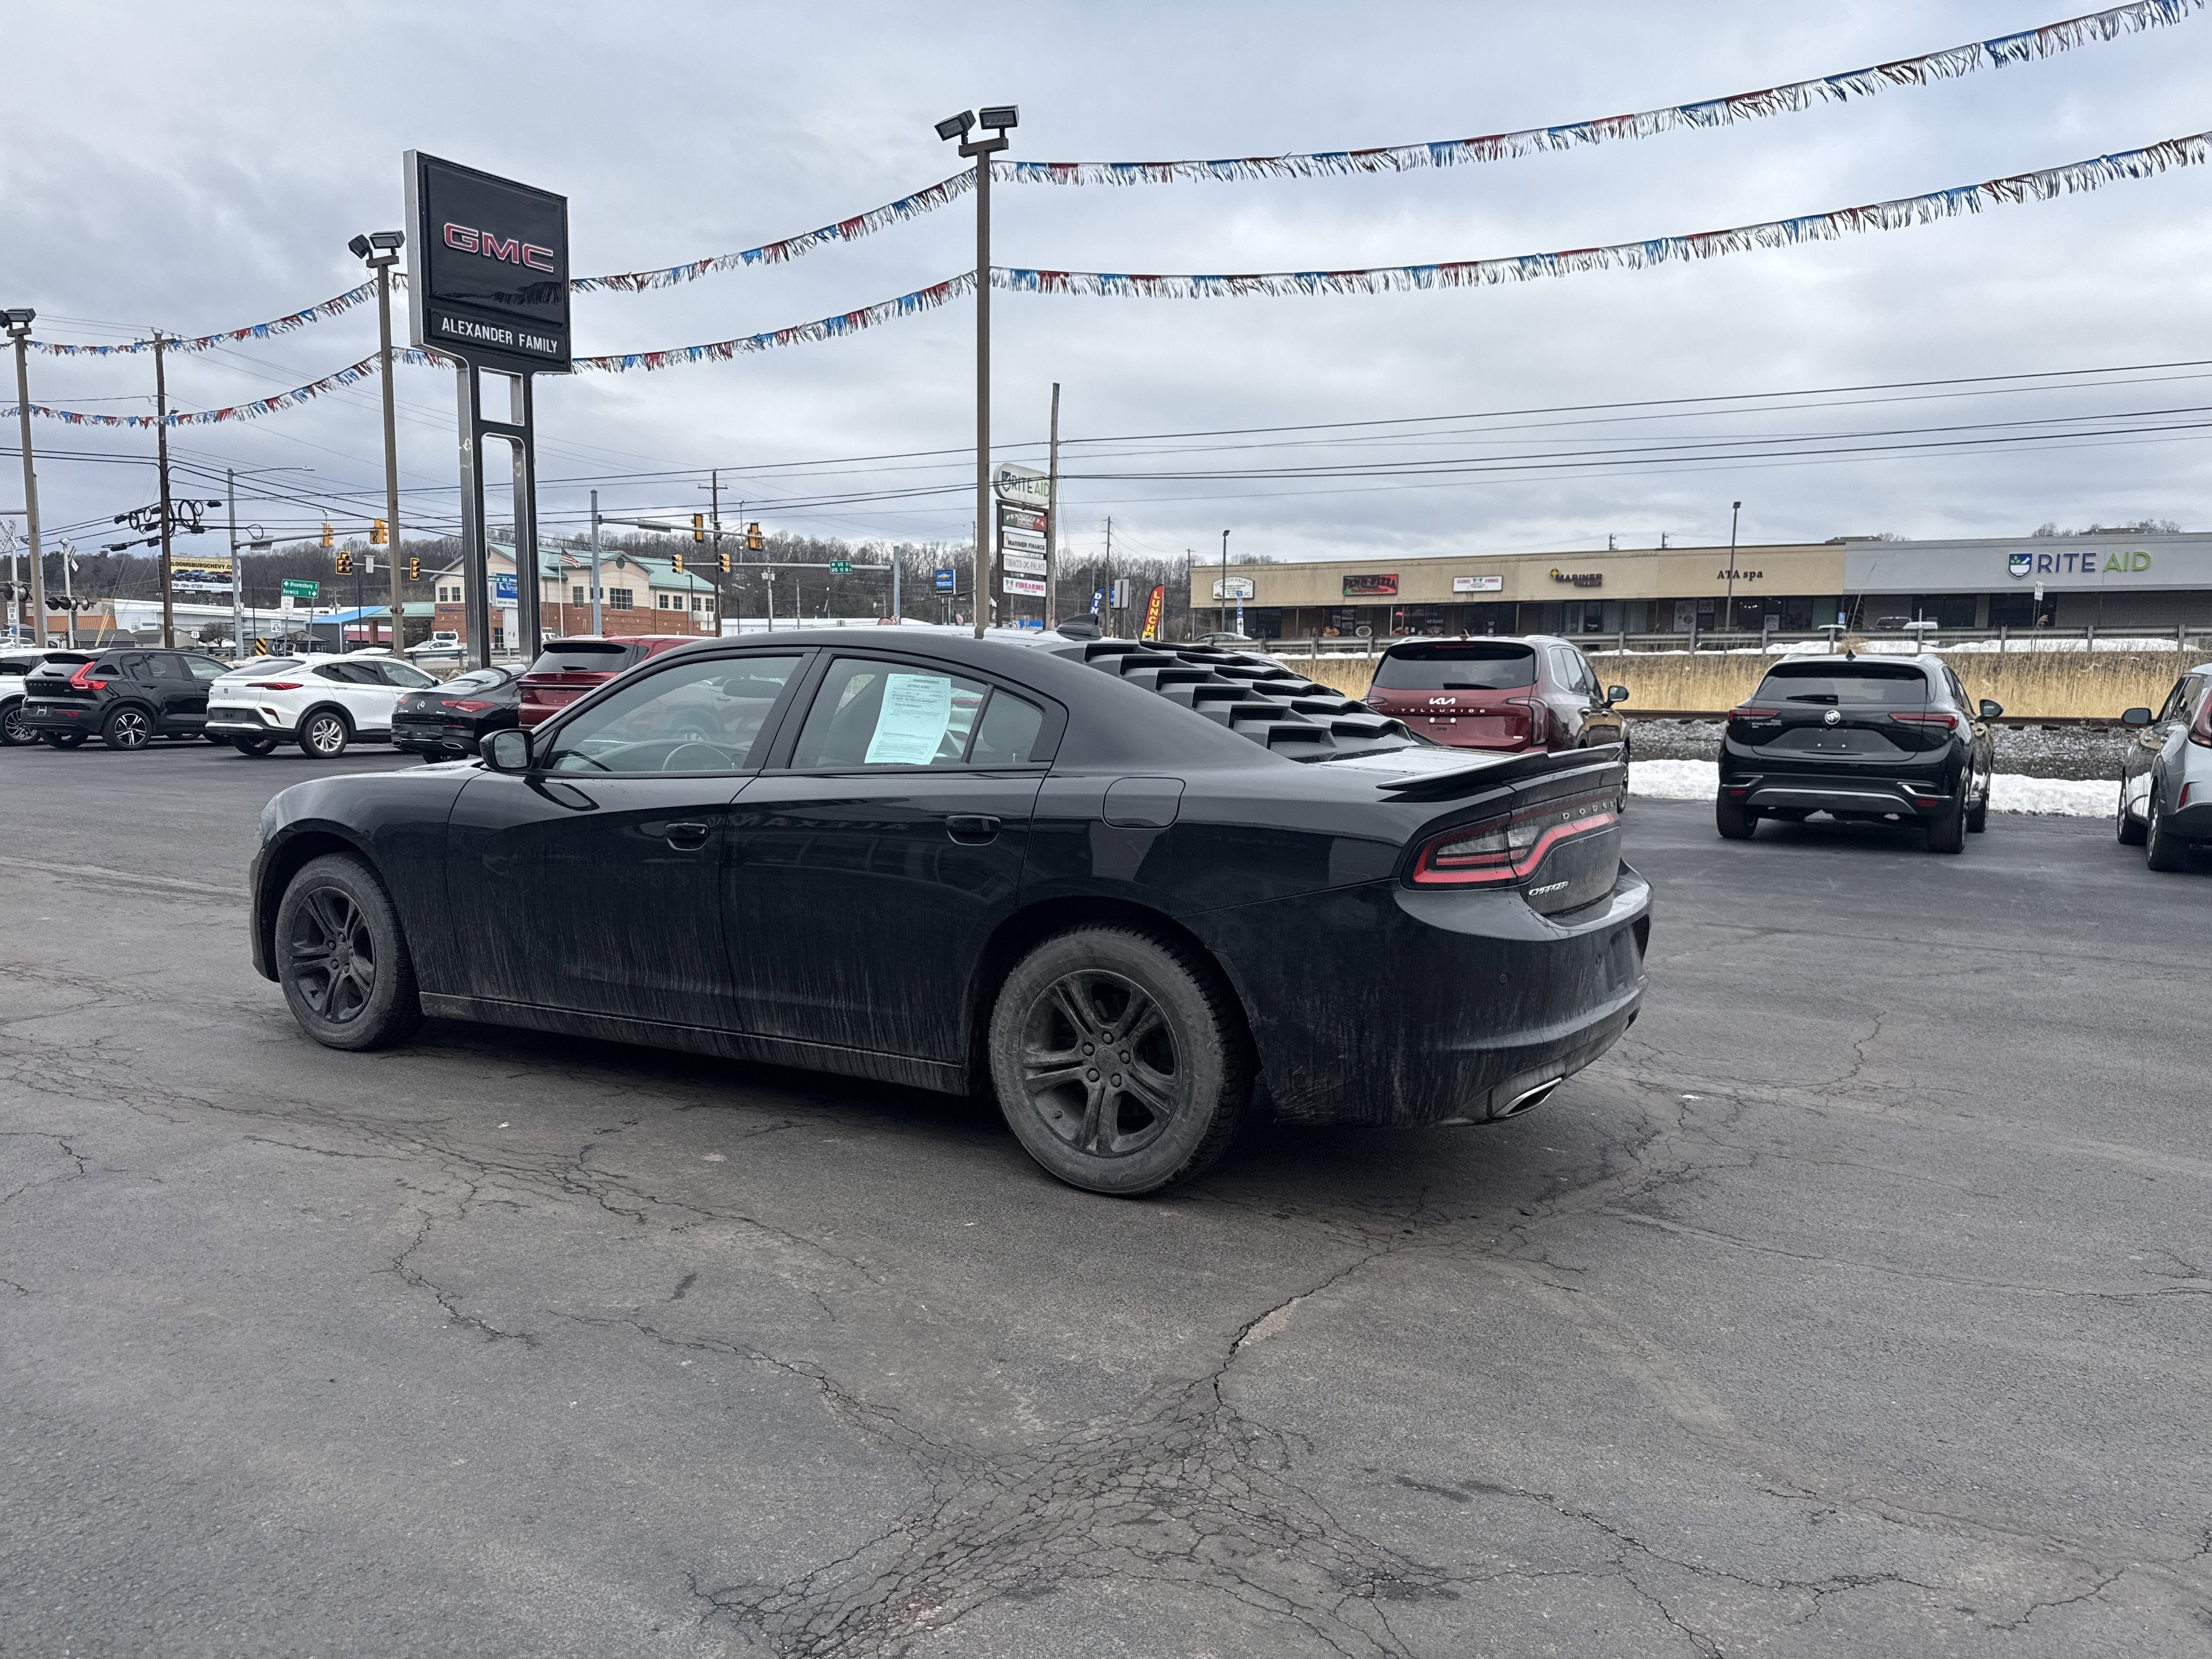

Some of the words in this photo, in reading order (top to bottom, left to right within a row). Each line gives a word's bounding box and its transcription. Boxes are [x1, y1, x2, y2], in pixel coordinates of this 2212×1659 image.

[444, 223, 554, 273] GMC
[442, 318, 512, 346] ALEXANDER
[518, 333, 557, 354] FAMILY
[1012, 475, 1032, 493] RITE
[1034, 482, 1050, 496] AID
[1025, 515, 1044, 527] PIZZA
[1005, 558, 1022, 568] TOBACCO
[1030, 562, 1045, 571] PALACE
[2038, 553, 2096, 573] RITE
[2103, 551, 2151, 572] AID
[1214, 578, 1234, 587] TOBCCO
[1344, 578, 1367, 590] PENN
[1372, 576, 1396, 589] PIZZA
[1717, 570, 1740, 579] ATA
[1743, 571, 1763, 581] spa
[1015, 582, 1045, 591] FIREARMS
[1146, 591, 1160, 633] LUNCH
[1562, 802, 1616, 820] DODGE
[1528, 881, 1568, 896] CHARGER
